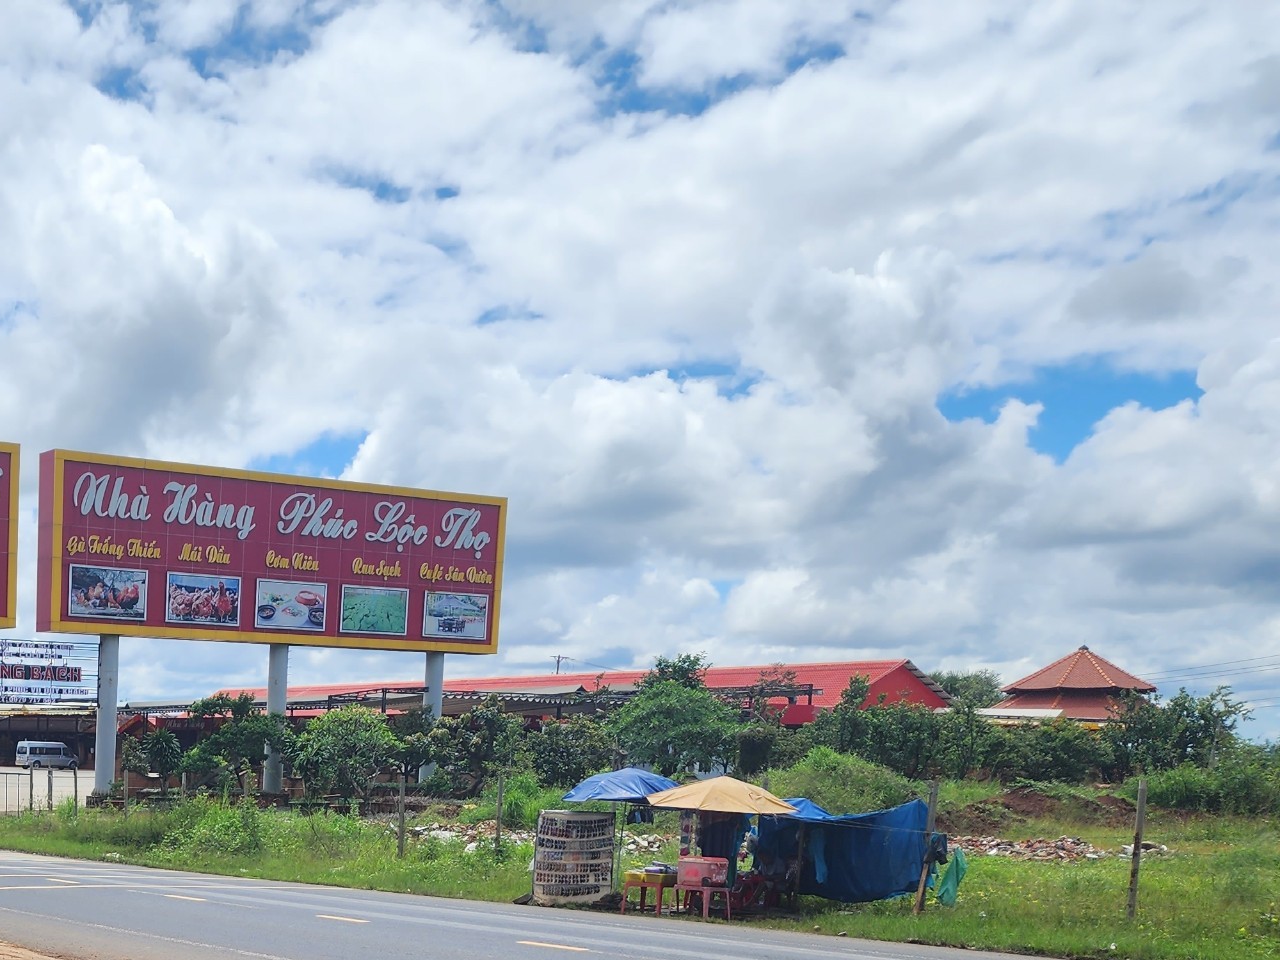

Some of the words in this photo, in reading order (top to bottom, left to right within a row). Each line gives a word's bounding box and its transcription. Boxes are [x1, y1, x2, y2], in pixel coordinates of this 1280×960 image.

[73, 471, 152, 521] Nhà
[163, 481, 256, 540] Hàng
[276, 492, 358, 541] Phúc
[365, 501, 428, 553] Lộc
[434, 507, 491, 560] Thọ
[66, 535, 86, 556] Gà
[88, 534, 125, 560] Trống
[127, 538, 161, 559] Thiến
[178, 543, 203, 562] Mái
[206, 545, 231, 565] Dầu
[266, 550, 290, 569] Cơm
[291, 552, 320, 571] Niêu
[352, 557, 375, 576] Rau
[375, 560, 402, 581] Sạch
[420, 562, 443, 584] Café
[444, 565, 465, 582] Sân
